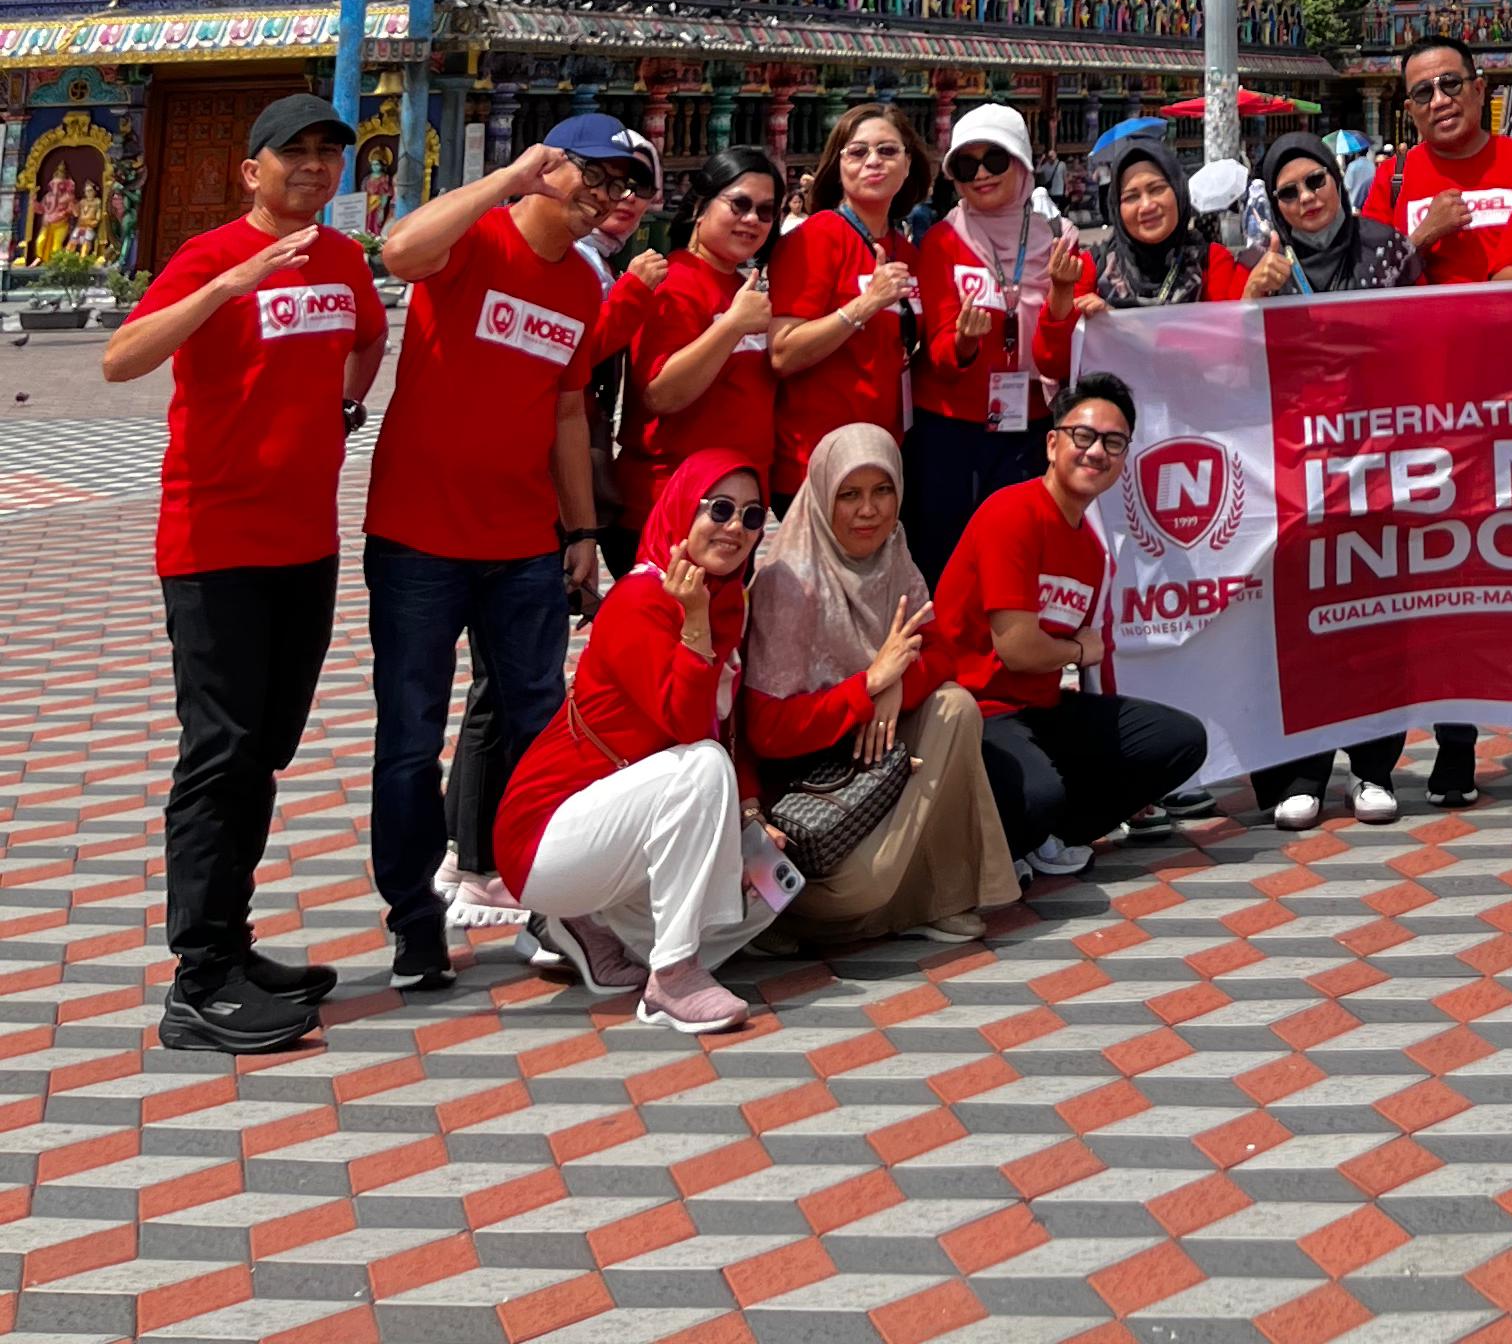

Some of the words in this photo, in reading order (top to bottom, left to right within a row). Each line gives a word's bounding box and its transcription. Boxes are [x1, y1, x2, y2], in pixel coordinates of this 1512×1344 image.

[1465, 195, 1512, 212] OBEL
[1155, 459, 1214, 512] N
[1305, 446, 1457, 525] ITB
[1173, 516, 1199, 529] 1999
[1317, 602, 1387, 626] KUALA
[1120, 619, 1194, 638] INDONESIA
